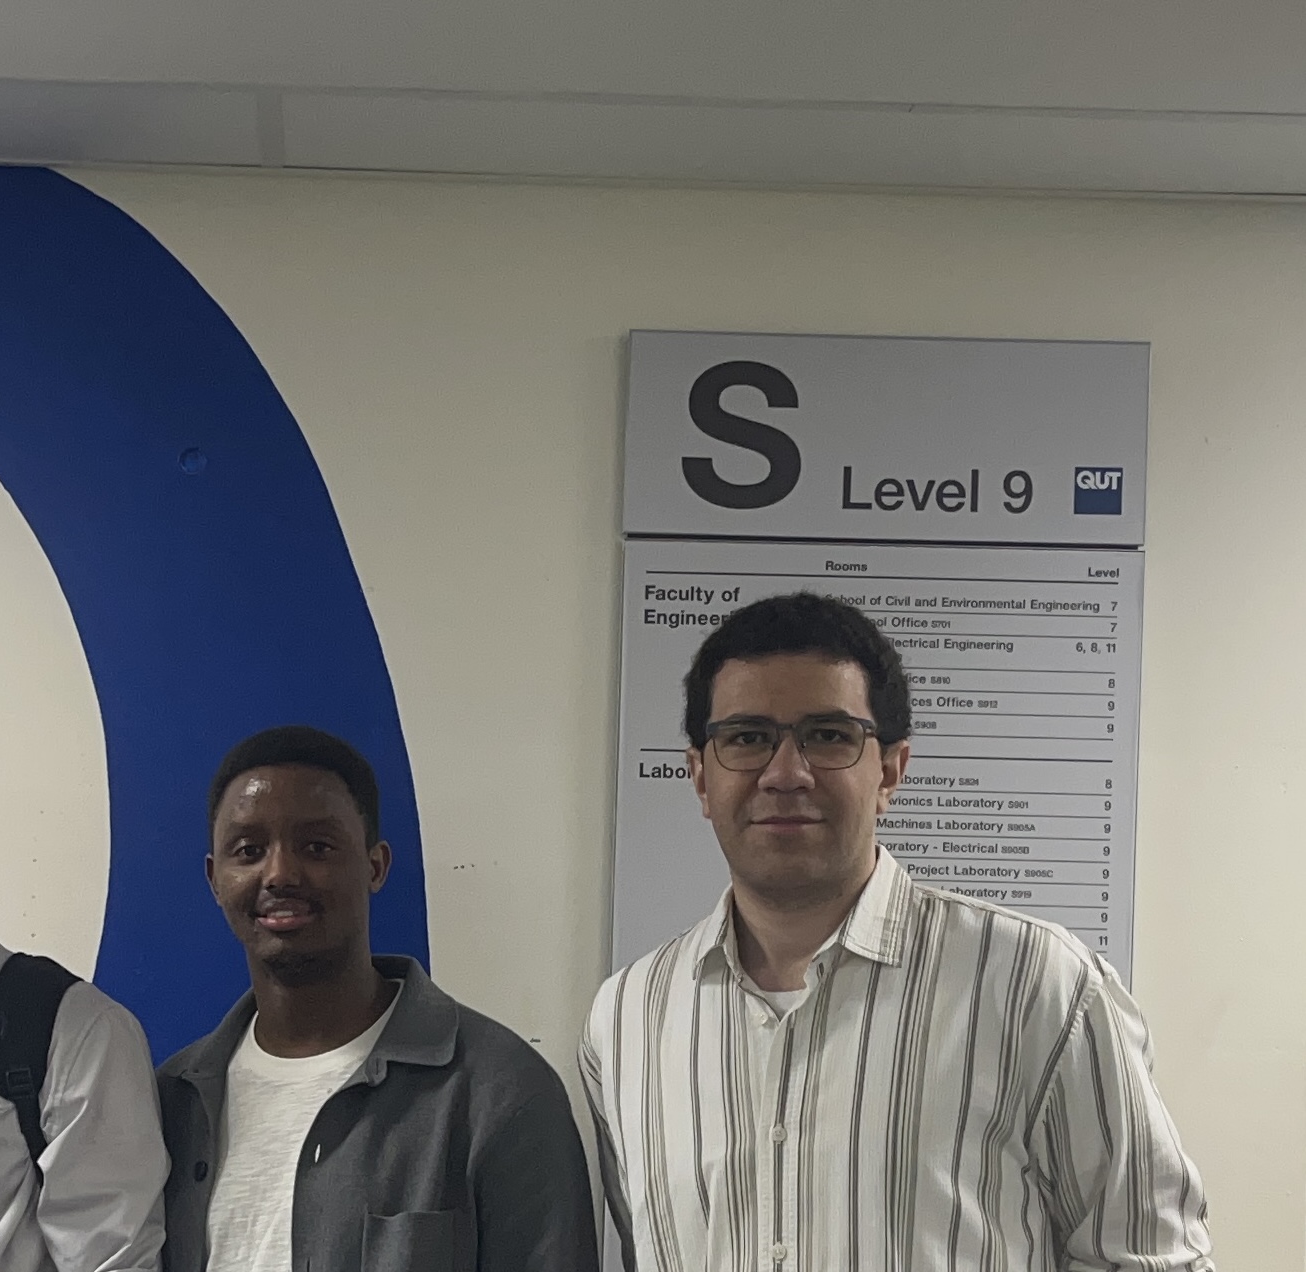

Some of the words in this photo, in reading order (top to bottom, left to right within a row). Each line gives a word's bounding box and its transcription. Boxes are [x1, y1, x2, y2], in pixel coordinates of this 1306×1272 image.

[681, 361, 802, 509] S
[842, 466, 979, 512] Level
[1003, 470, 1033, 513] 9
[1077, 471, 1121, 490] QUT
[825, 560, 867, 572] Rooms
[1088, 567, 1119, 578] Level
[645, 585, 714, 605] Faculty
[721, 587, 740, 602] of
[870, 595, 882, 606] of
[886, 596, 910, 607] Civil
[915, 597, 937, 608] and
[942, 597, 1026, 610] Environmental
[1031, 599, 1100, 613] Engineering
[1111, 601, 1118, 611] 7
[892, 617, 928, 628] Office
[1110, 622, 1118, 632] 7
[944, 638, 1014, 653] Engineering
[1106, 643, 1117, 653] 11
[1108, 679, 1115, 689] 8
[936, 696, 973, 707] Office
[1107, 701, 1115, 711] 9
[1107, 724, 1114, 734] 9
[1105, 779, 1112, 789] 8
[889, 796, 933, 807] vionics
[937, 796, 1004, 810] Laboratory
[1104, 801, 1111, 811] 9
[876, 818, 933, 830] Machines
[936, 820, 1003, 833] Laboratory
[1103, 823, 1111, 834] 9
[942, 841, 998, 853] Electrical
[1103, 846, 1110, 856] 9
[907, 863, 949, 877] Project
[953, 865, 1020, 879] Laboratory
[1102, 868, 1110, 879] 9
[1101, 891, 1108, 902] 9
[1100, 912, 1108, 923] 9
[1098, 935, 1108, 946] 11
